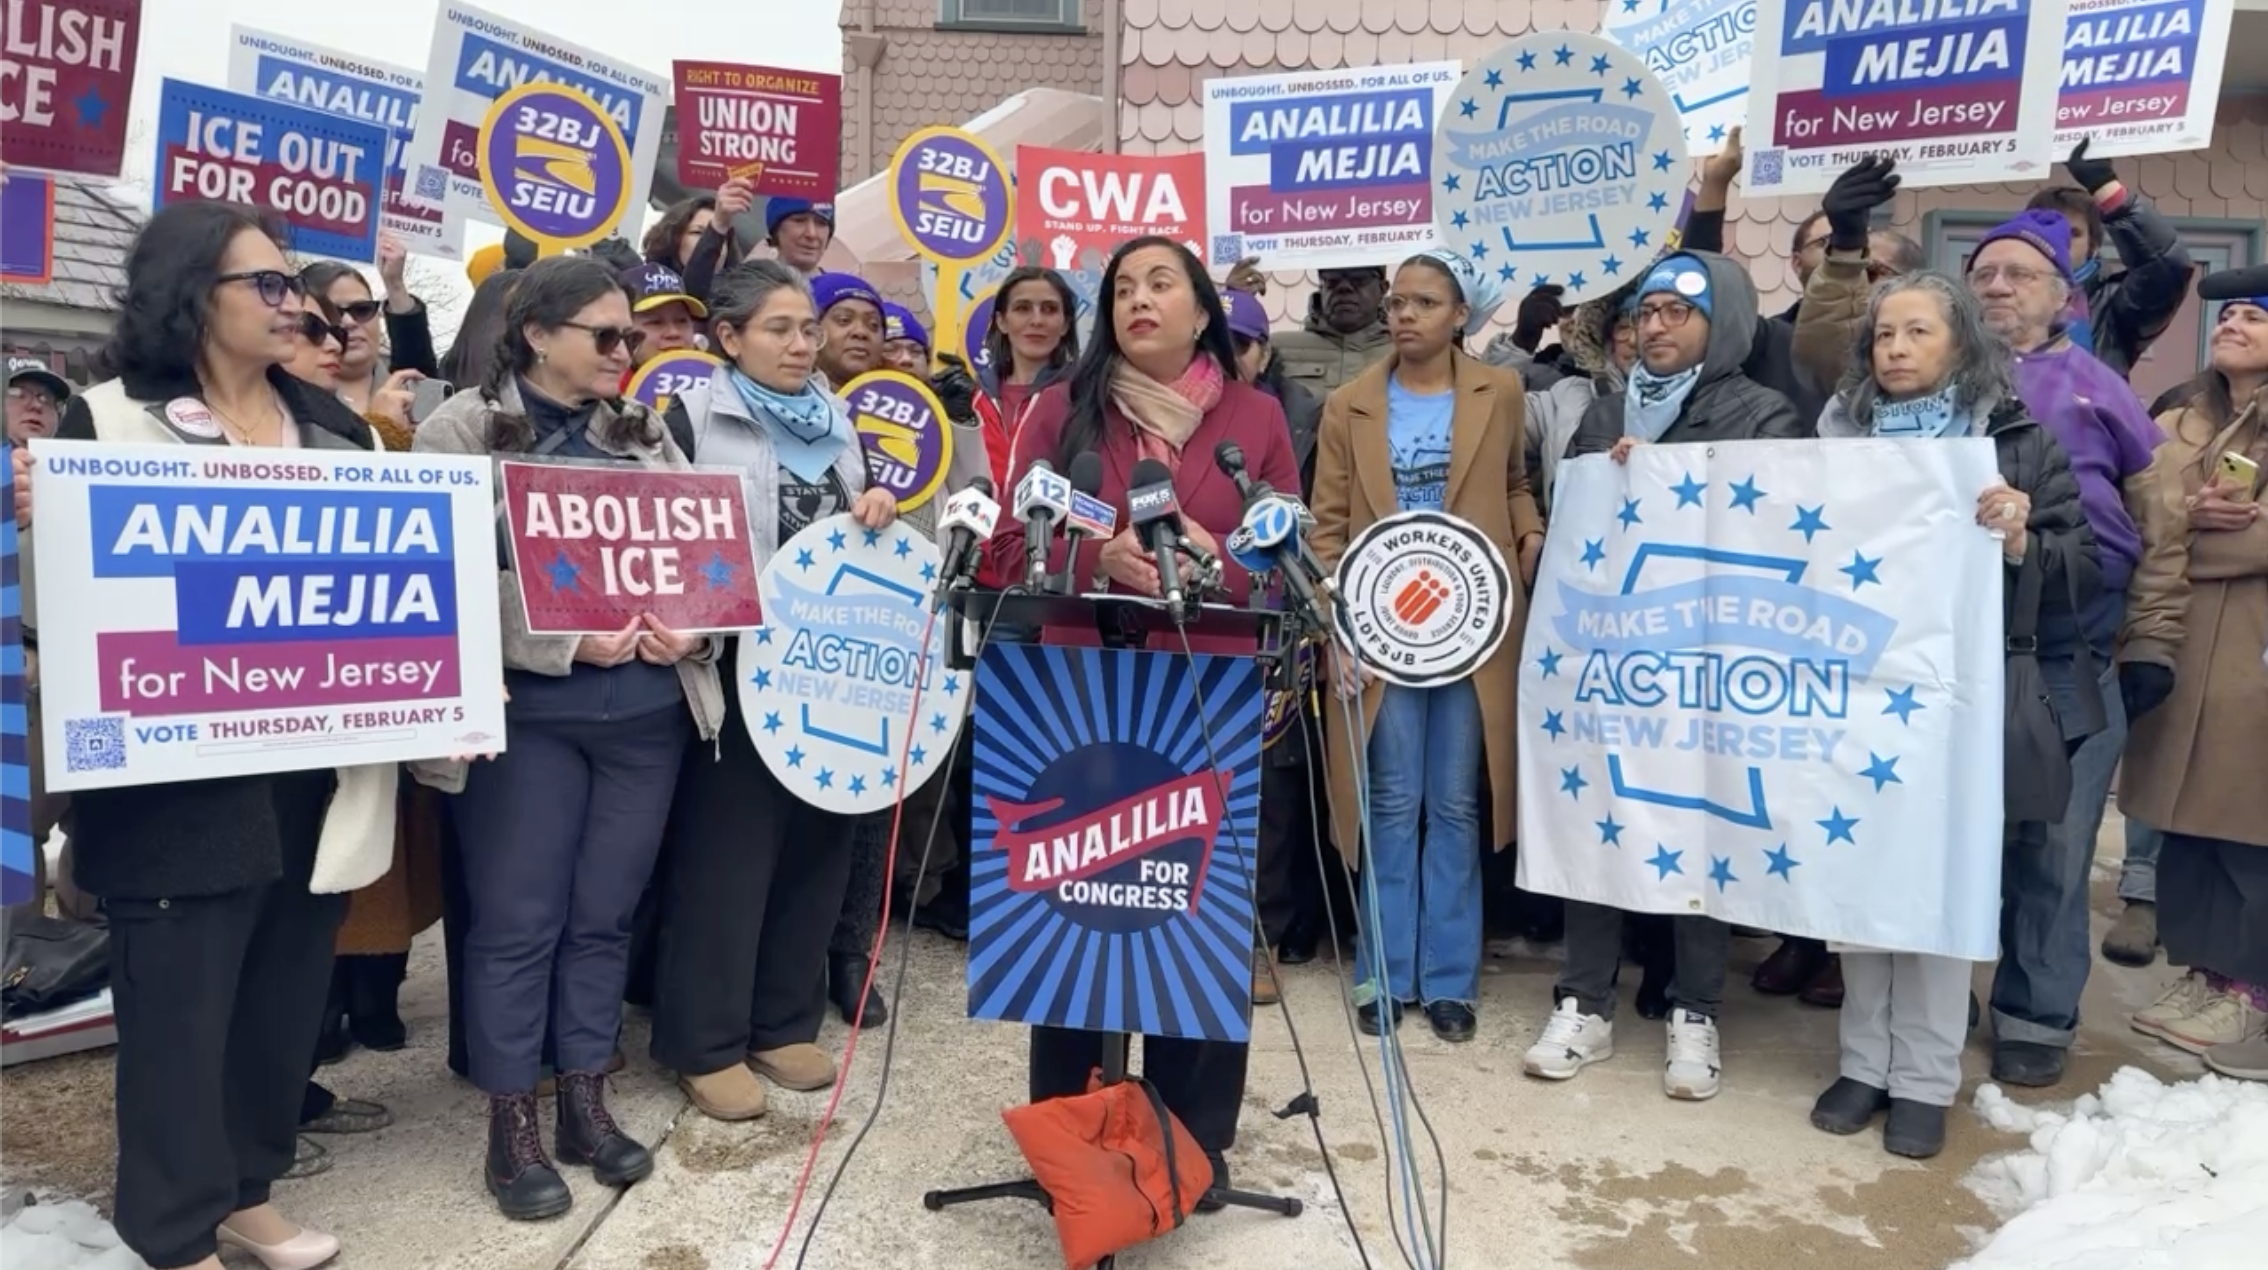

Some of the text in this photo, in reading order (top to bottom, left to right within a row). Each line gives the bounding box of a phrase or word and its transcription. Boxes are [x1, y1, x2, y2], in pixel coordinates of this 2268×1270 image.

[5, 0, 126, 73] LISH
[1633, 8, 1691, 46] MAKE
[1645, 0, 1757, 72] ACTIO
[2064, 8, 2191, 50] ALILIA
[239, 35, 423, 88] UNBOUGHT. UNBOSSED. FOR A
[448, 9, 661, 96] UNBOUGHT. UNBOSSED. FOR ALL OF US.
[1660, 41, 1753, 92] EW JER
[1851, 28, 2010, 86] MEJIA
[2059, 46, 2182, 88] MEJIA
[0, 60, 57, 127] CE
[267, 70, 421, 129] ANALILI
[686, 69, 820, 94] RIGHT TO ORGANIZE
[1212, 71, 1452, 99] UNBOUGHT. UNBOSSED. FOR ALL OF US.
[515, 106, 601, 148] 32BJ
[699, 97, 798, 136] UNION
[1240, 99, 1424, 142] ANALILIA
[1785, 99, 2006, 138] for New Jersey
[2058, 95, 2178, 121] ew Jersey
[186, 111, 263, 165] ICE
[279, 131, 364, 184] OUT
[700, 130, 797, 164] STRONG
[1469, 115, 1641, 160] MAKE THE ROAD
[2106, 122, 2174, 138] FEBRUARY
[2177, 121, 2185, 132] 5
[451, 139, 479, 169] fo
[918, 147, 989, 182] 32BJ
[1295, 143, 1422, 182] MEJIA
[1474, 141, 1636, 202] ACTION
[1789, 154, 1826, 168] VOTE
[1919, 140, 2003, 158] FEBRUARY
[2006, 139, 2017, 152] 5
[171, 156, 366, 223] FOR GOOD
[452, 181, 483, 198] VOTE
[511, 182, 596, 219] SEIU
[1039, 166, 1188, 223] CWA
[1474, 184, 1637, 226] NEW JERSEY
[384, 217, 432, 236] BRUARY
[916, 212, 986, 243] SEIU
[1044, 220, 1183, 236] STAND UP. FIGHT BACK.
[1240, 196, 1422, 225] for New Jersey
[1247, 230, 1434, 251] VOTE THURSDAY, FEBRUARY 5
[654, 373, 711, 393] 32B
[857, 389, 931, 429] 32BJ
[48, 457, 481, 486] UNBOUGHT. UNBOSSED. FOR ALL OF US.
[869, 458, 917, 489] EIU
[1040, 479, 1066, 506] 12
[111, 503, 440, 555] ANALILIA
[525, 492, 736, 541] ABOLISH
[1229, 529, 1254, 550] abc
[600, 547, 685, 596] ICE
[1382, 530, 1491, 630] WORKERS UNITED
[225, 573, 441, 628] MEJIA
[790, 599, 849, 626] MAKE
[853, 606, 893, 626] THE
[1354, 610, 1416, 665] LDFSJB
[1576, 595, 1868, 656] MAKE THE ROAD
[119, 652, 443, 699] for New Jersey
[782, 627, 933, 691] ACTION
[777, 670, 838, 702] NEW
[1575, 648, 1850, 720] ACTION
[135, 706, 465, 744] VOTE THURSDAY, FEBRUARY 5
[1573, 714, 1848, 763] NEW JERSEY
[1023, 785, 1209, 882] ANALILIA
[1140, 859, 1190, 885] FOR
[1058, 880, 1189, 911] CONGRESS
